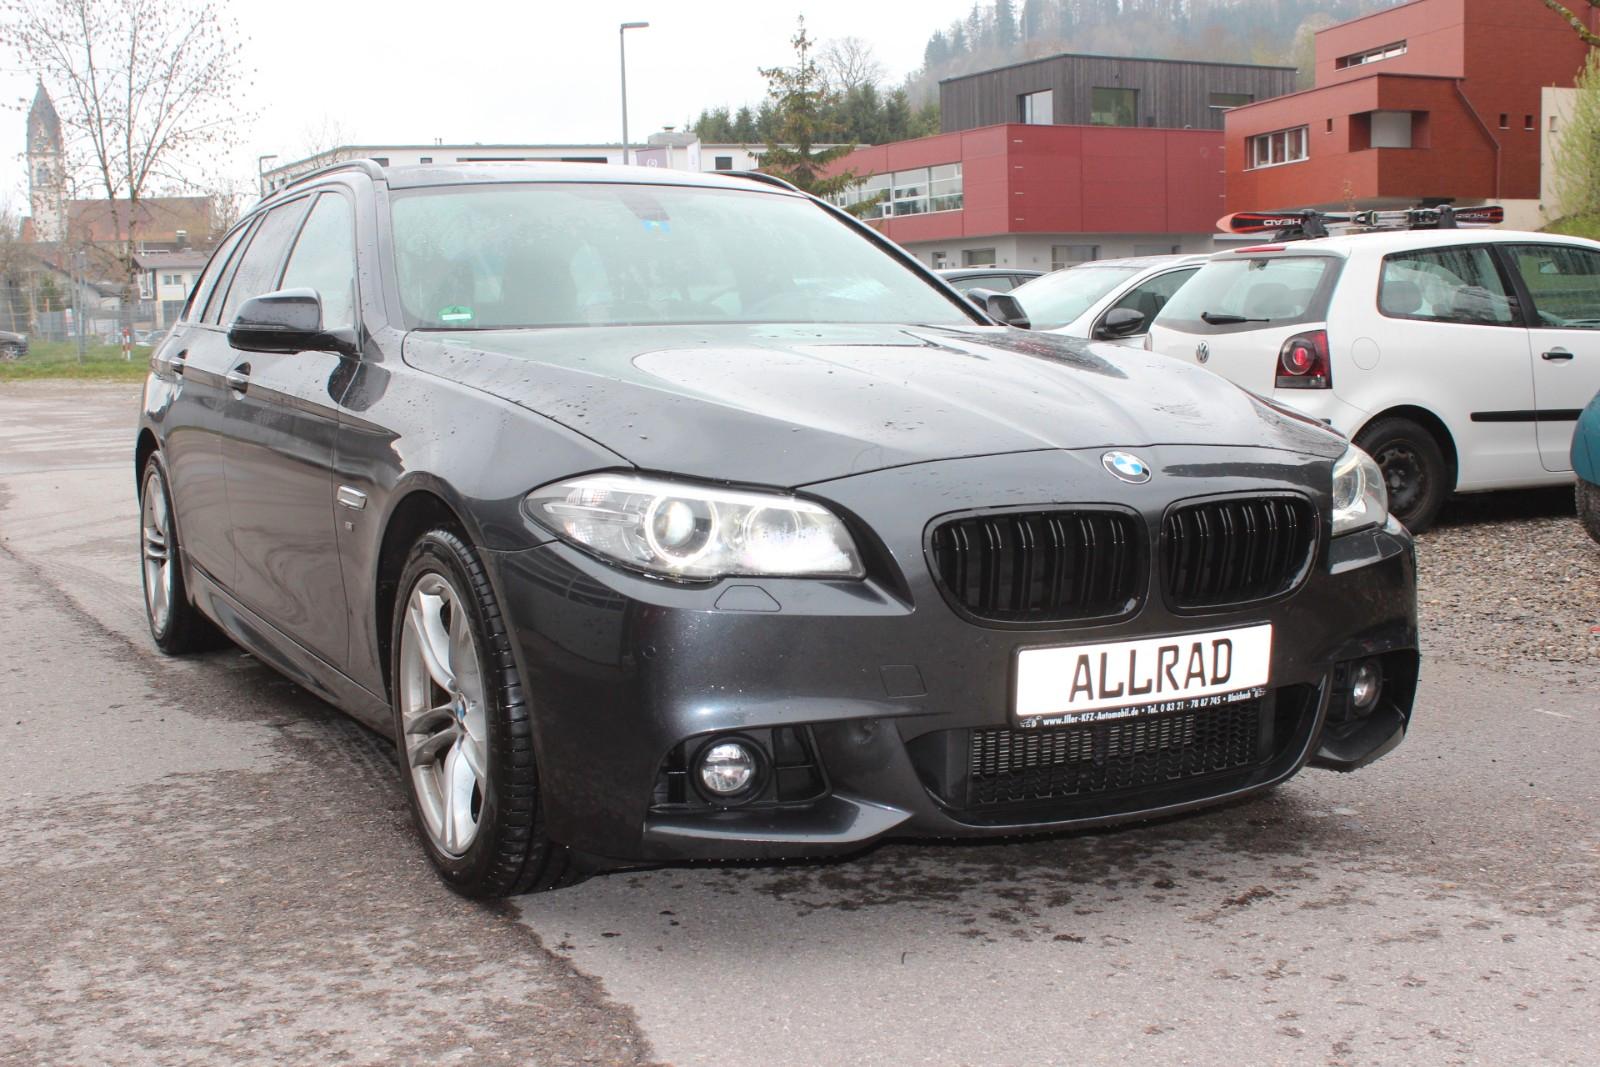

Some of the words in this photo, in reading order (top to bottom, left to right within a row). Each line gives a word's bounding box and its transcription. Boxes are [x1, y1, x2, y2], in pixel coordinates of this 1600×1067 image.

[1263, 218, 1301, 227] HEAD
[1068, 638, 1233, 702] ALLRAD
[1147, 704, 1159, 714] Tel.
[1160, 703, 1165, 712] 0
[1166, 702, 1175, 711] 83
[1176, 701, 1184, 710] 21
